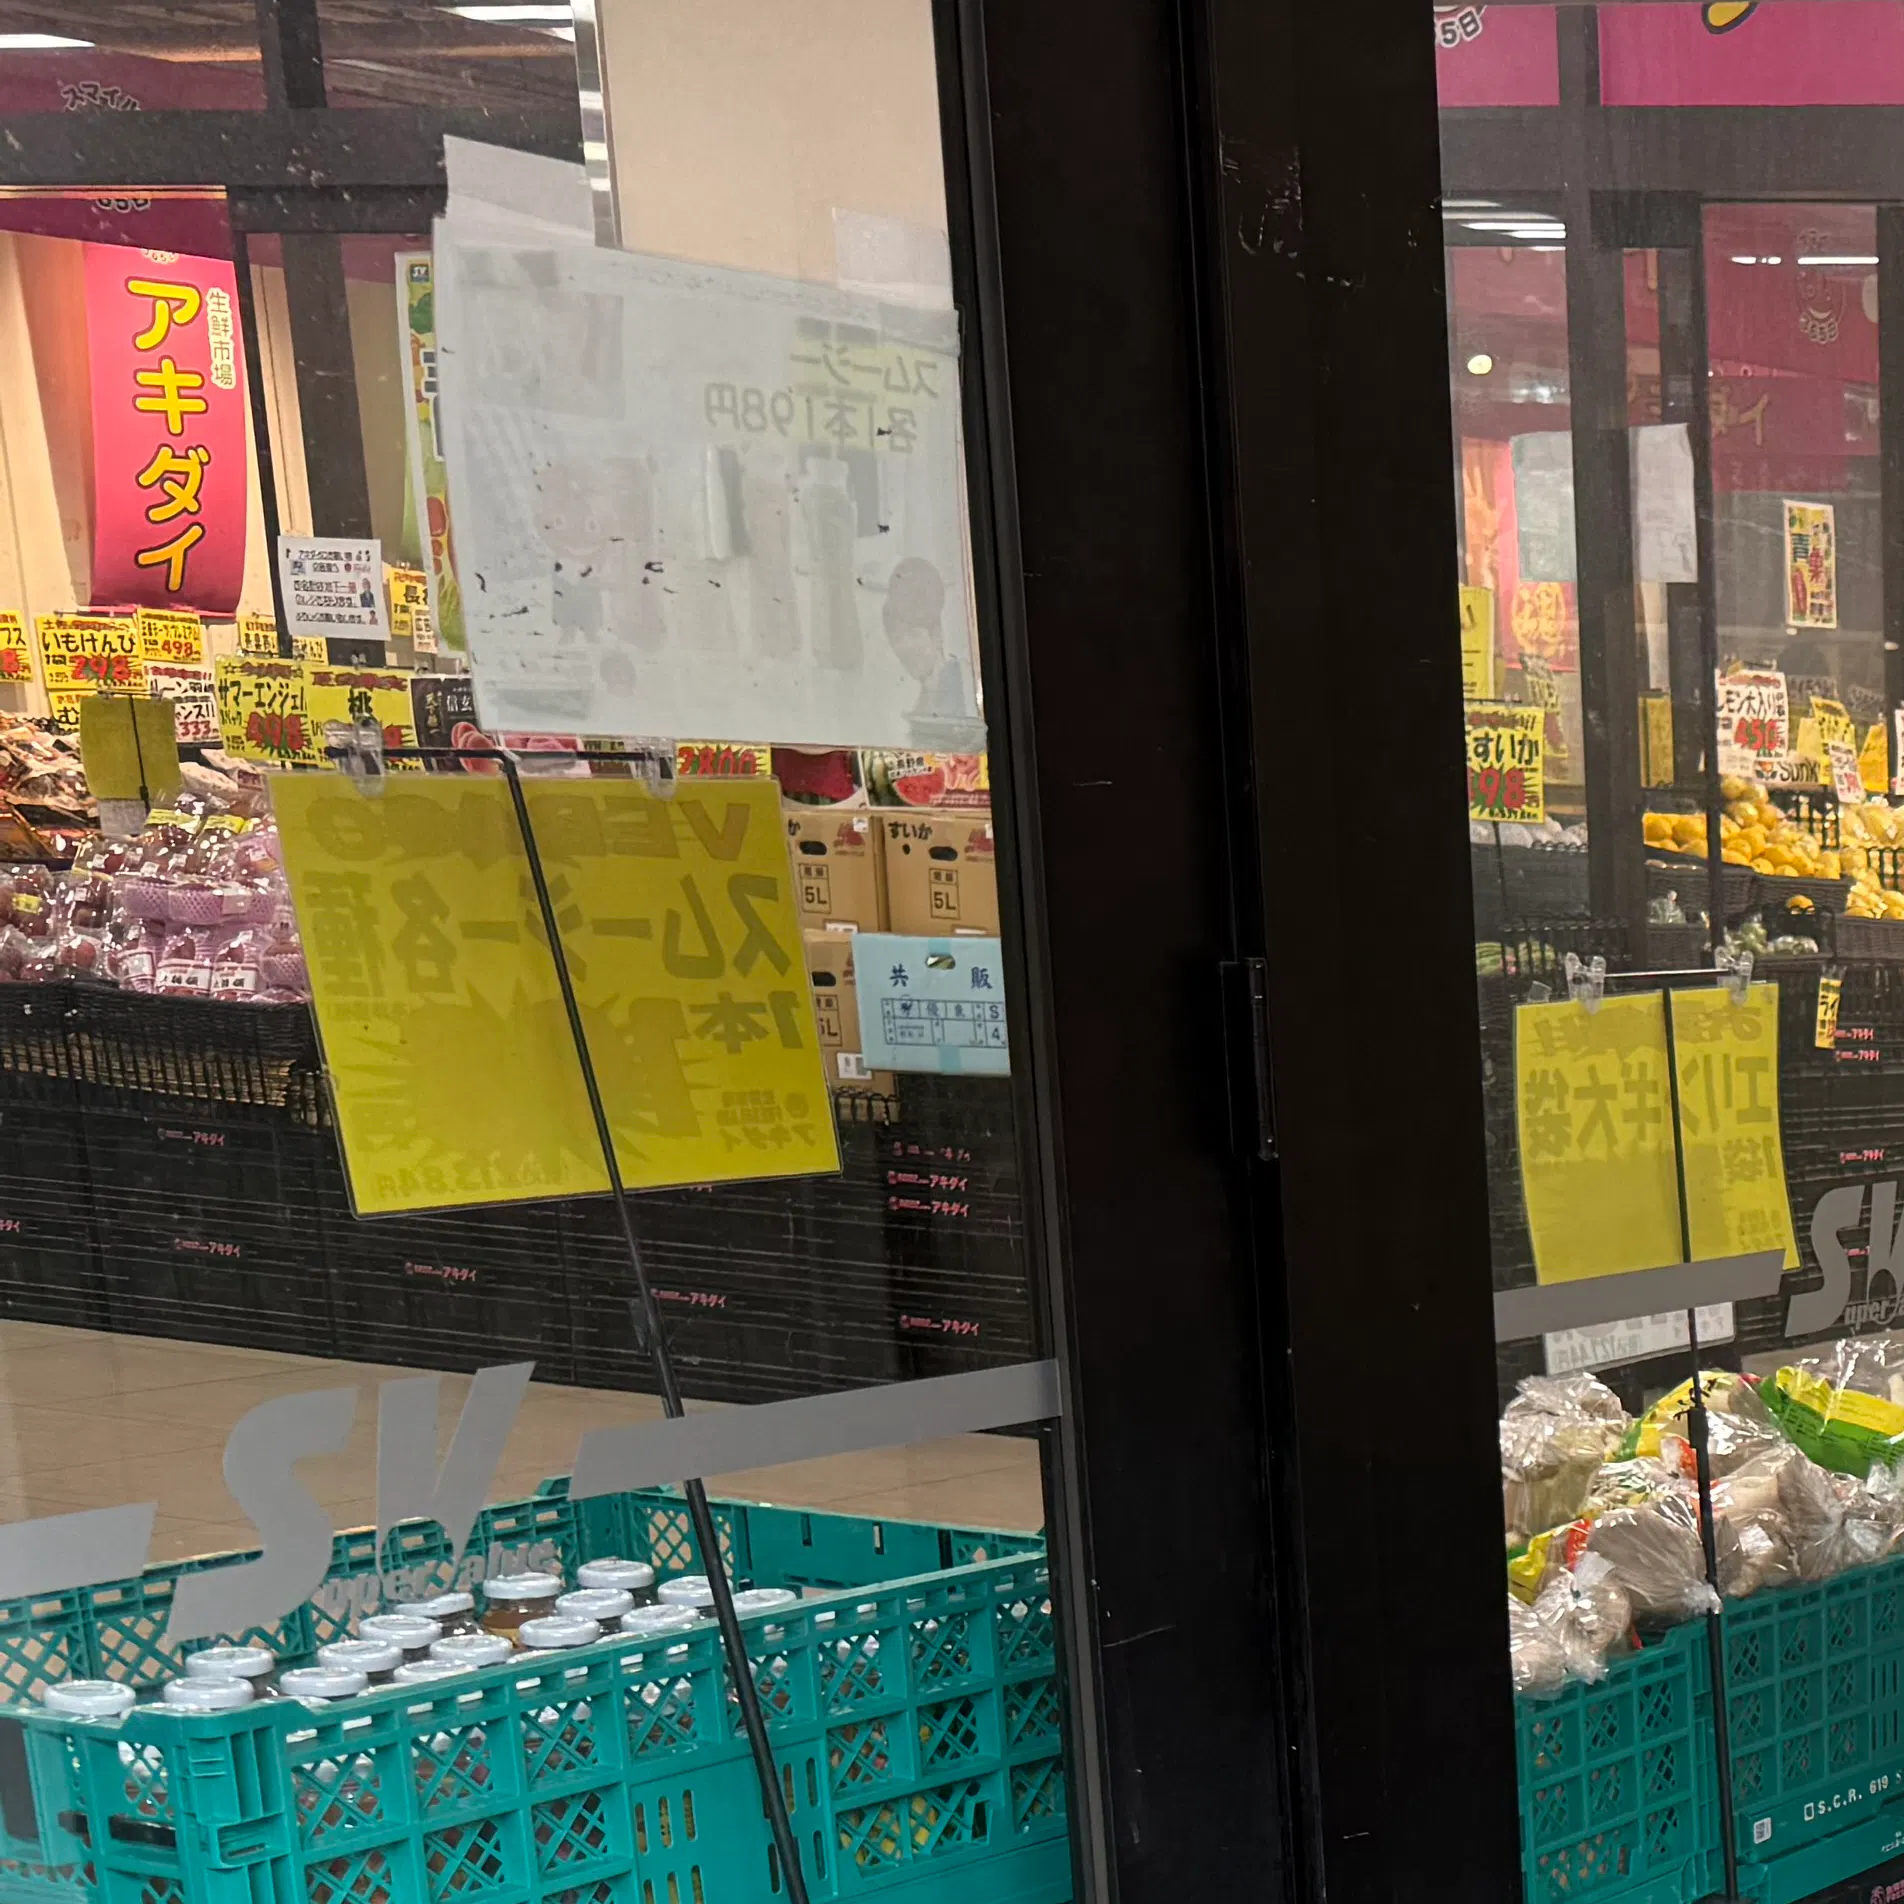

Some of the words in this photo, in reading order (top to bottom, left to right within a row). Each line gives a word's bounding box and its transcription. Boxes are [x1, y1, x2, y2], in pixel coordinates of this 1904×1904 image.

[208, 288, 236, 390] 生鮮市場
[125, 275, 211, 596] アキダイ
[70, 654, 131, 681] 298
[1472, 733, 1540, 766] すいか
[1467, 767, 1526, 809] 98
[1869, 1775, 1889, 1795] 619
